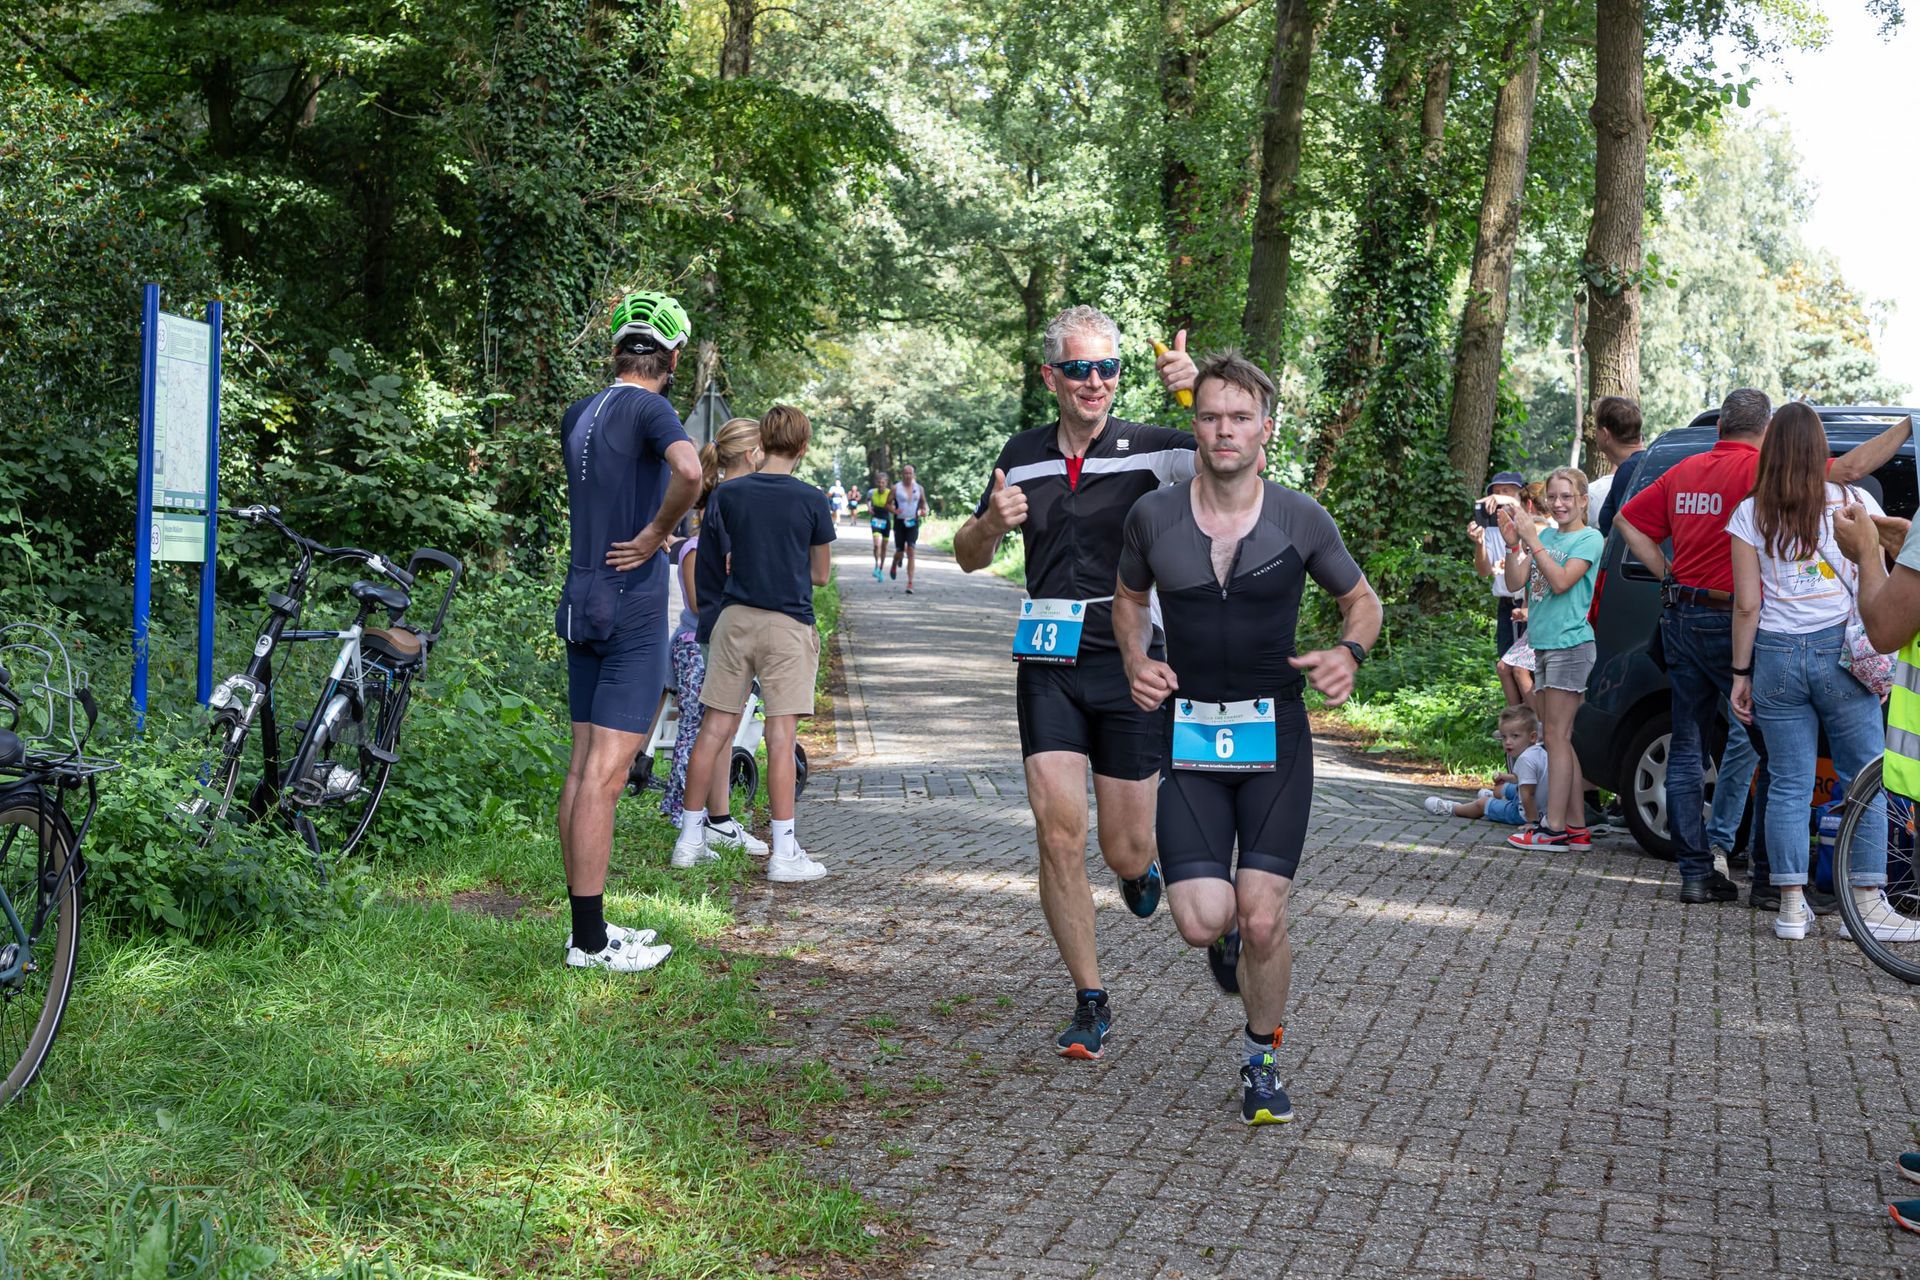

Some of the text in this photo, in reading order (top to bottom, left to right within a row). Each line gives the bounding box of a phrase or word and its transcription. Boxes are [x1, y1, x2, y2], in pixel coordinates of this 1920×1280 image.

[1675, 492, 1723, 516] EHBO
[1031, 622, 1058, 652] 43
[1215, 728, 1235, 759] 6
